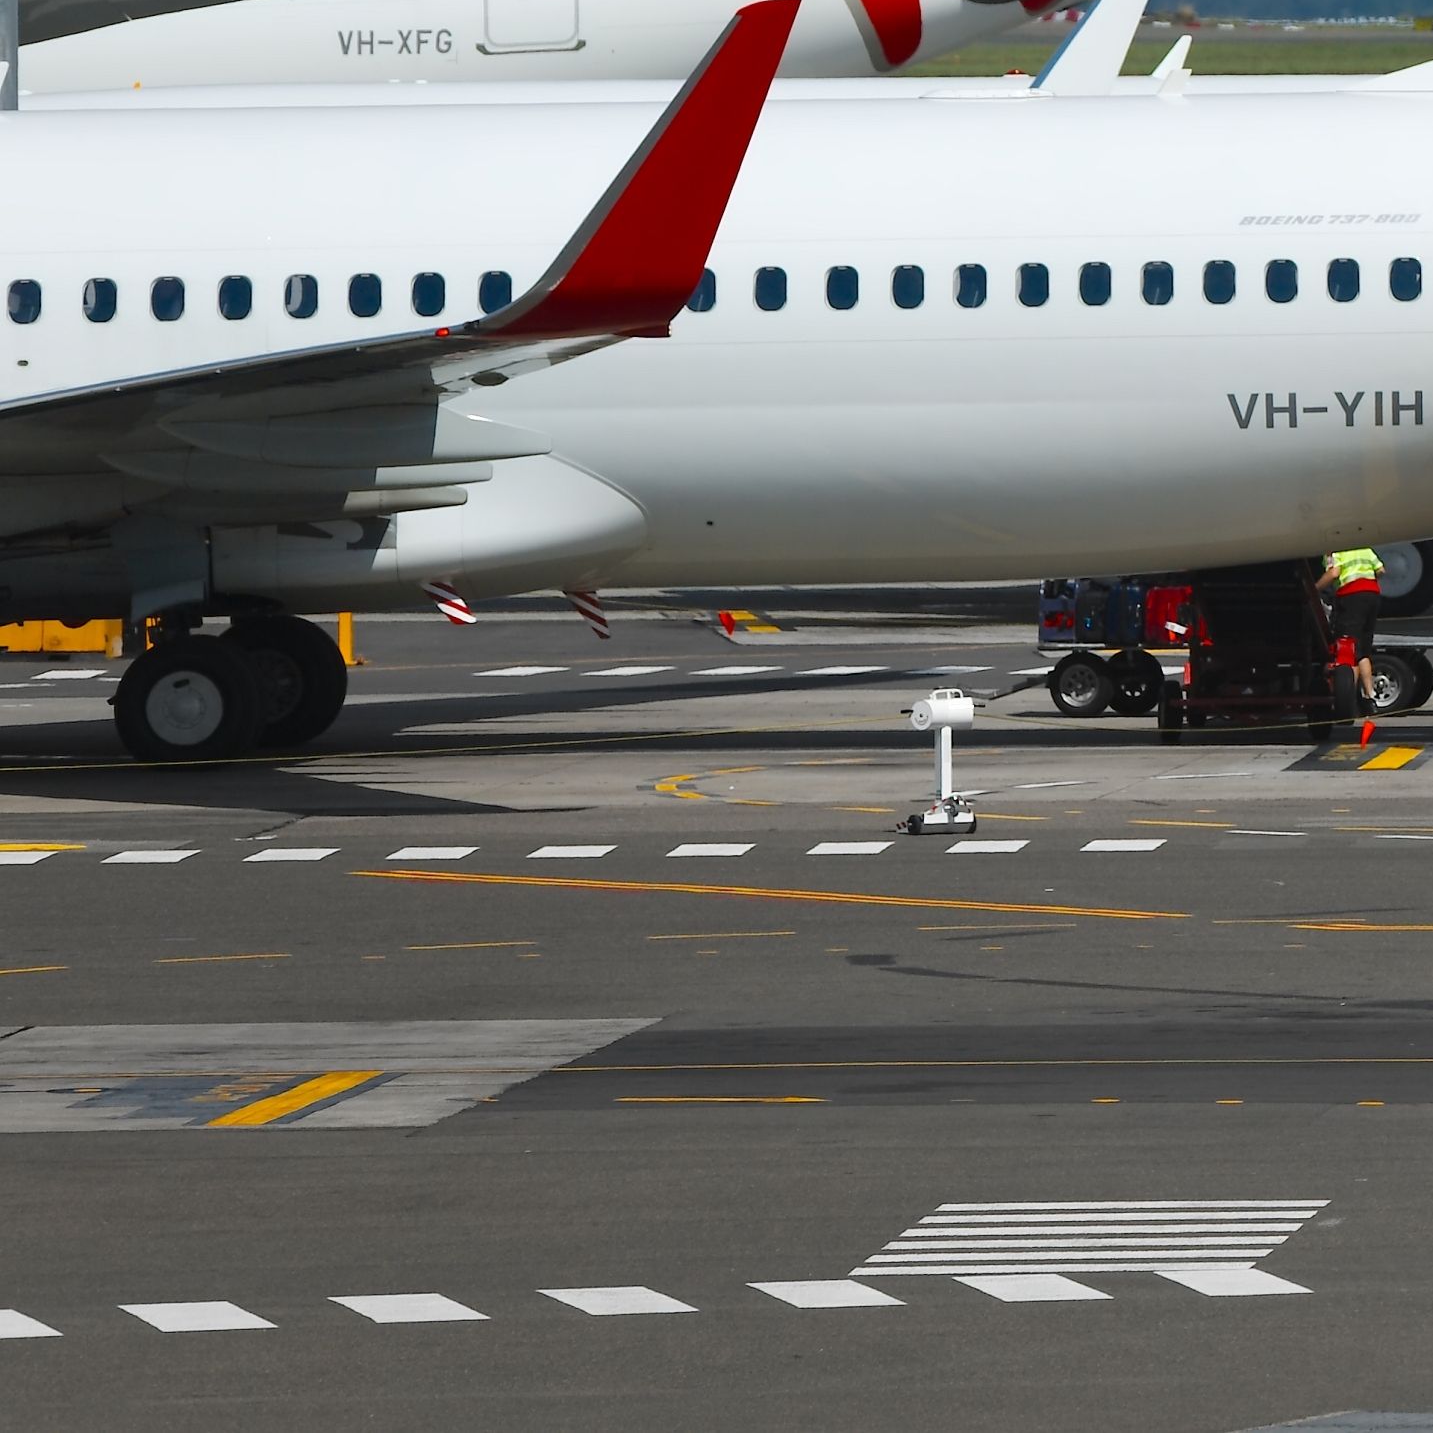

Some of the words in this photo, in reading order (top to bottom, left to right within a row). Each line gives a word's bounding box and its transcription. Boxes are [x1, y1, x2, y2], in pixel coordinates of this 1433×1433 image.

[337, 28, 453, 55] VH-XFG
[1239, 215, 1325, 226] BOEING
[1226, 390, 1424, 429] VH-YIH
